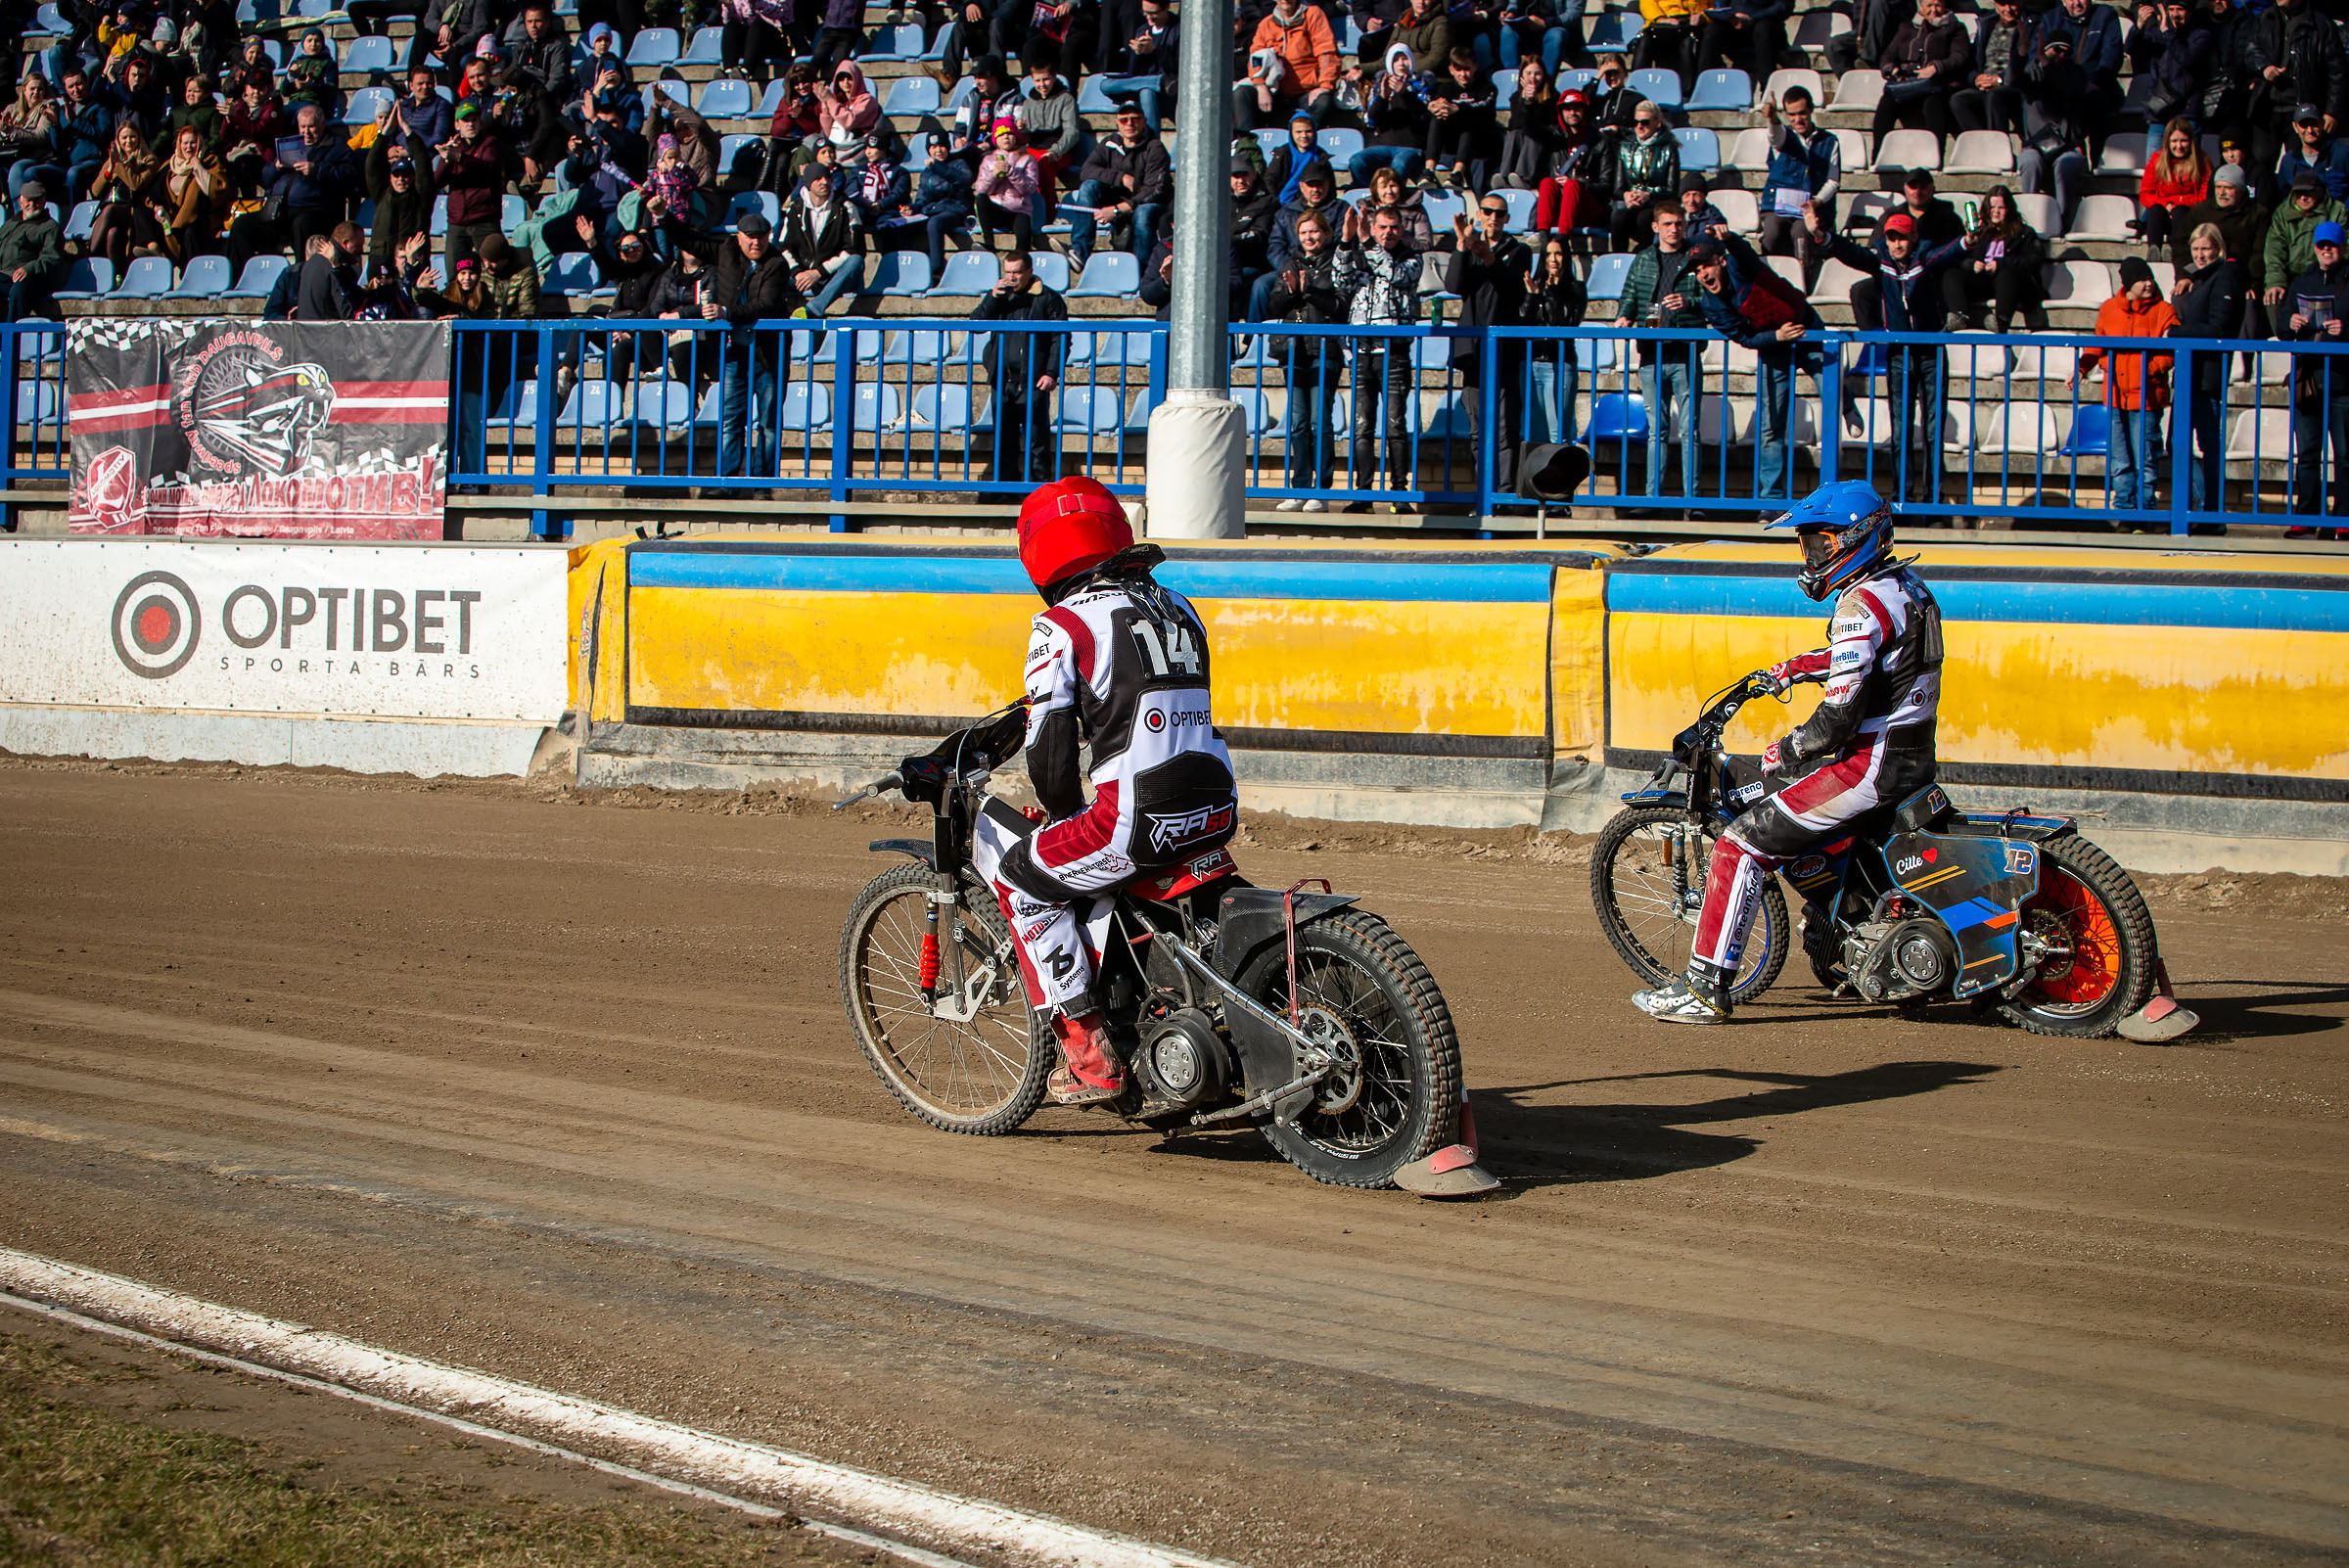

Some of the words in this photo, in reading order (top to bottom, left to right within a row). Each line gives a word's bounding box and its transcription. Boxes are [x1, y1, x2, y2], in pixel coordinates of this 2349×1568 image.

[456, 260, 475, 271] OBEY
[199, 331, 284, 365] DAUGAVPILS
[182, 364, 204, 397] club
[180, 400, 195, 429] fan
[185, 428, 242, 474] speedway
[222, 584, 481, 655] OPTIBET
[1130, 619, 1200, 675] 14
[220, 657, 361, 675] SPORTA
[390, 658, 482, 679] BĀRS
[1728, 782, 1763, 800] Pureno
[1927, 789, 1947, 815] 12
[1896, 854, 1924, 876] Cille
[2004, 849, 2034, 875] 12
[1059, 965, 1085, 991] Systems
